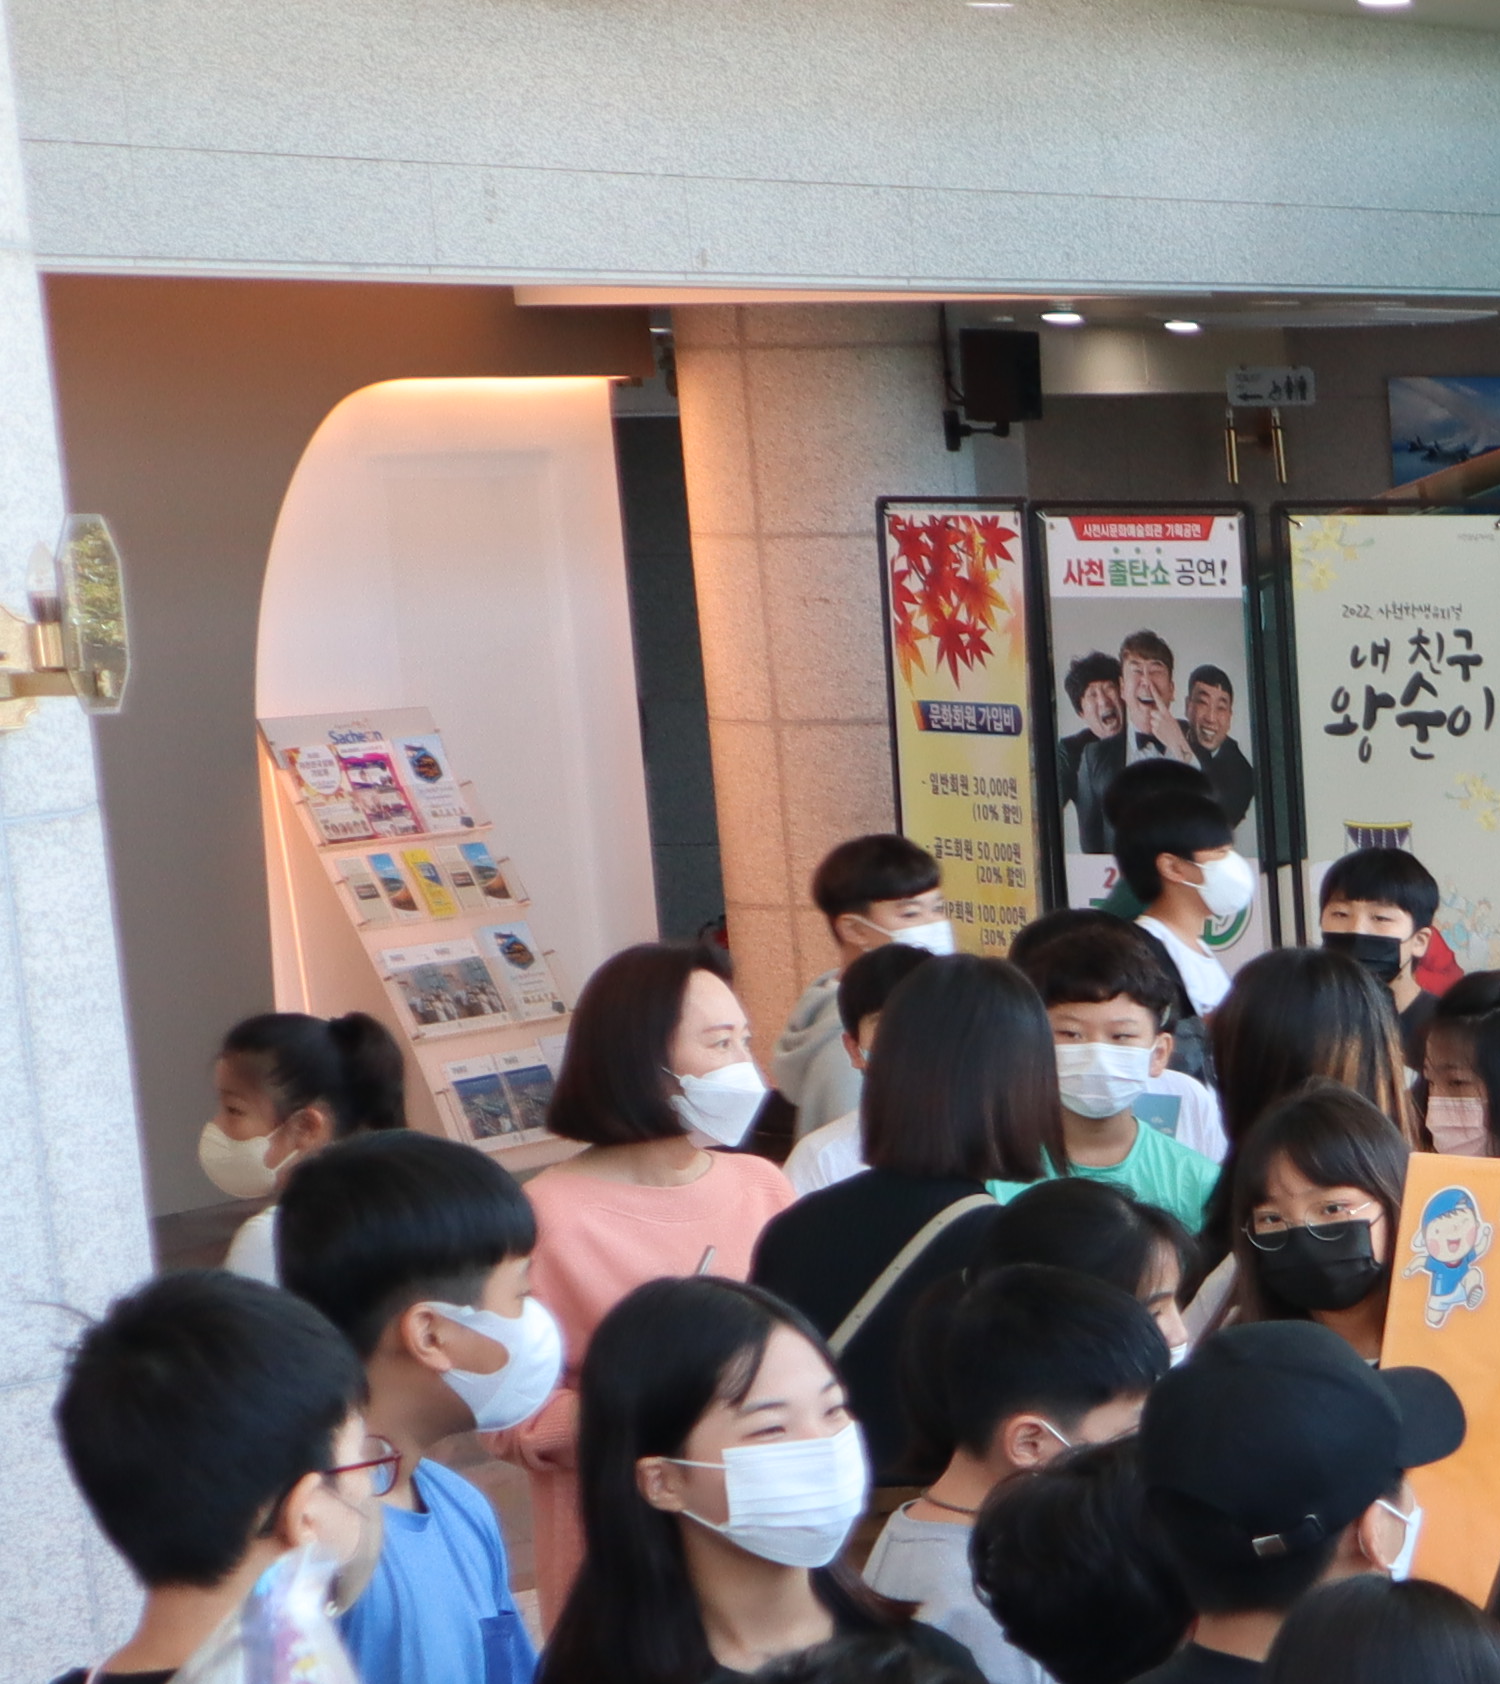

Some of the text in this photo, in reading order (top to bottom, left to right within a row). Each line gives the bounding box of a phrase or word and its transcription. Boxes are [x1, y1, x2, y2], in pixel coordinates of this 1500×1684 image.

[1082, 522, 1202, 538] 사천시문화예술회관 기획공연
[1063, 558, 1228, 586] 사천 졸탄쇼 공연!
[1342, 604, 1372, 619] 2022
[1350, 627, 1483, 682] 내 친구
[928, 702, 1016, 734] 문화회원 가입비
[1324, 671, 1495, 763] 왕순이
[328, 730, 383, 745] Sacheon
[929, 773, 1018, 800] 일반회원 30,000원
[972, 804, 1023, 825] (10% 할인)
[933, 836, 1021, 864] 골드회원 50,000원
[976, 867, 1027, 889] (20% 할인)
[945, 902, 974, 925] IP회원
